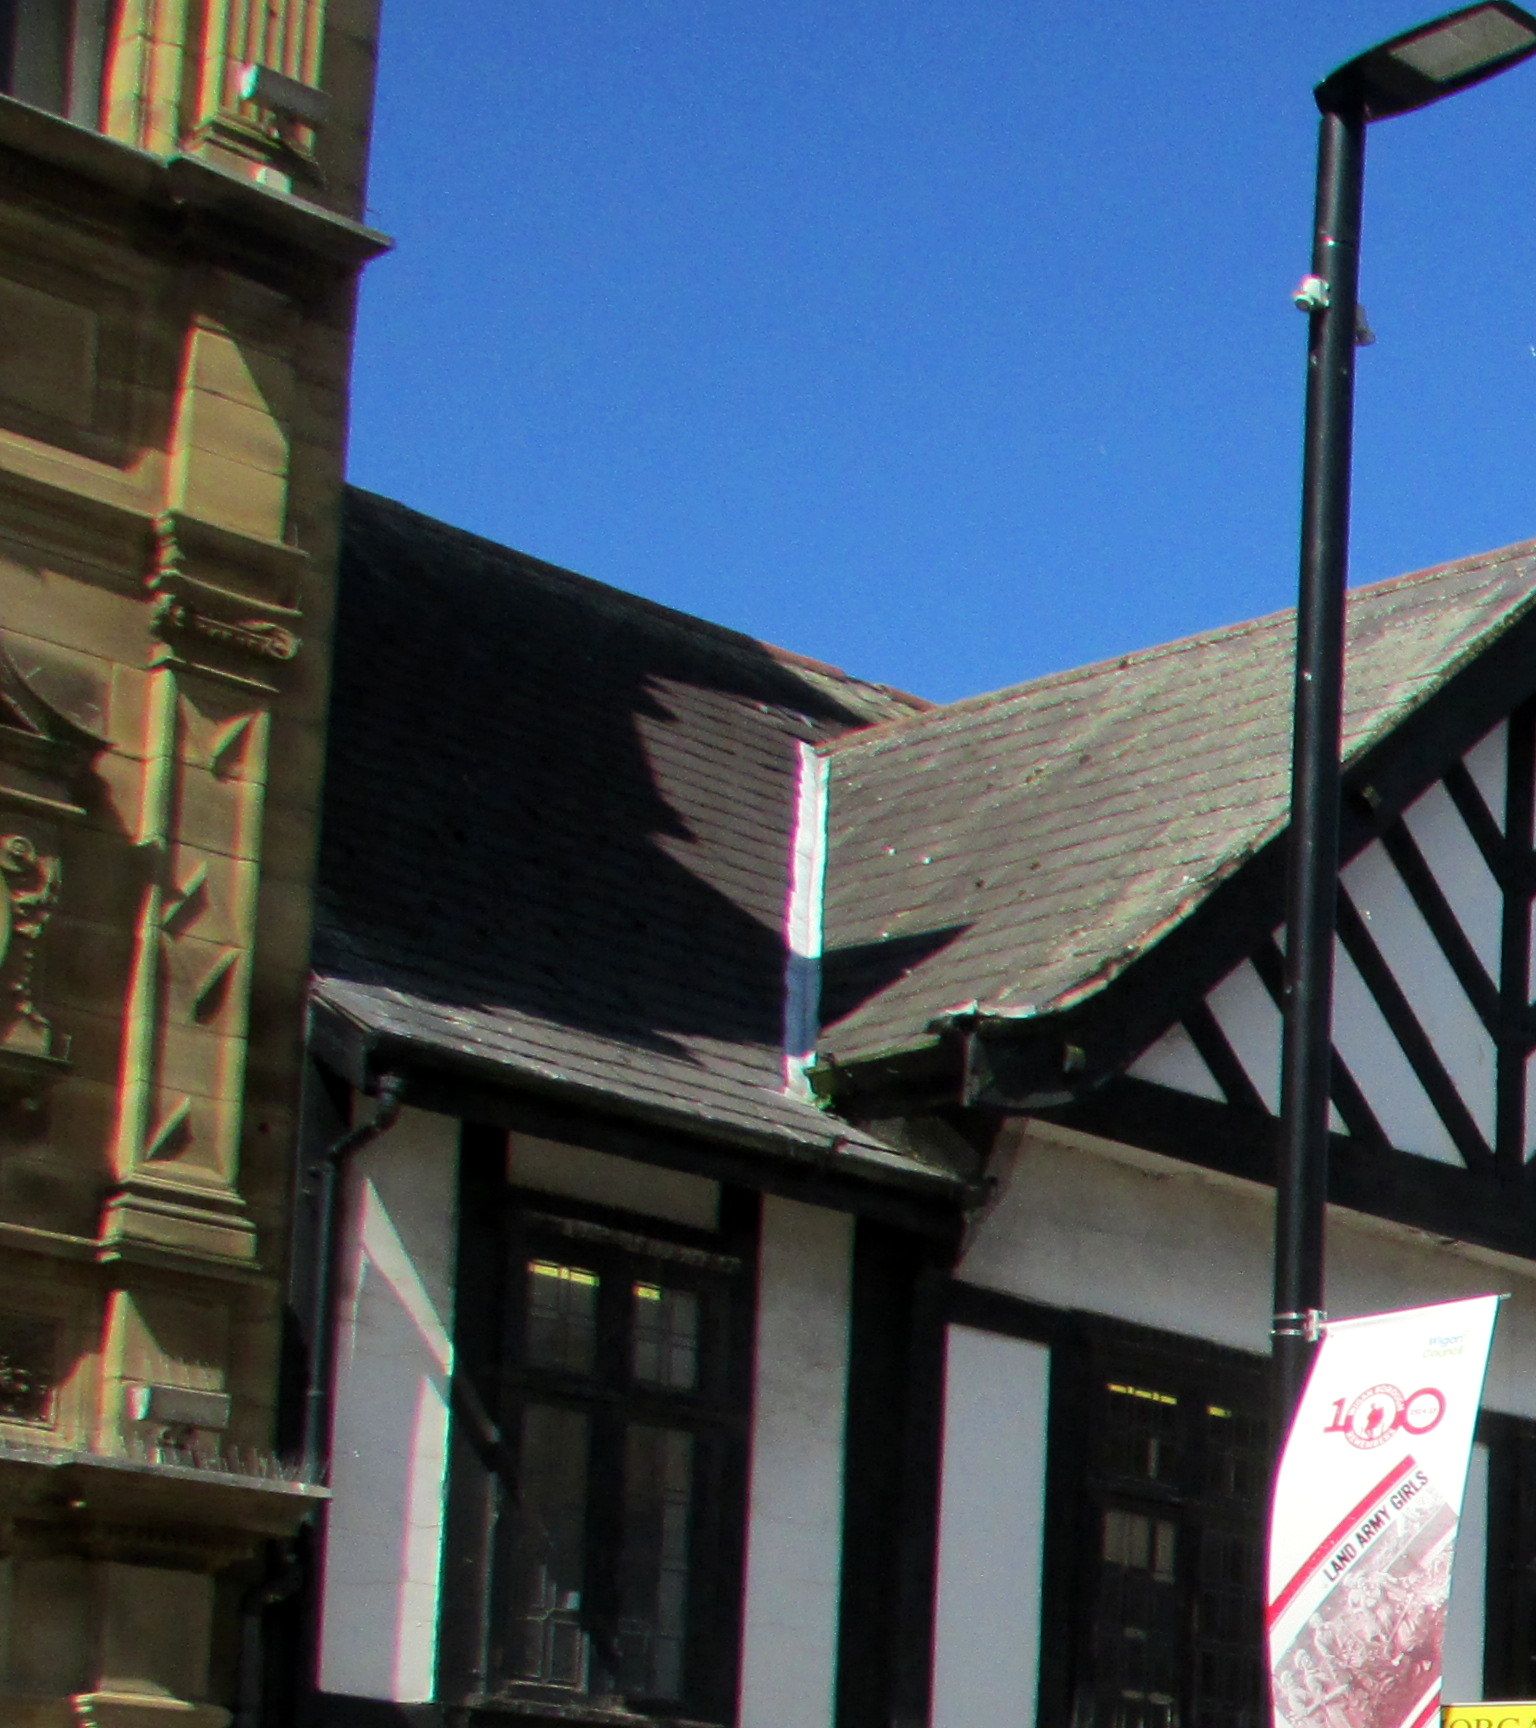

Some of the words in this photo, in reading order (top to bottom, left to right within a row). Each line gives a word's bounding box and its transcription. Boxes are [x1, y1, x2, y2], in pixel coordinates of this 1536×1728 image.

[1324, 1543, 1357, 1582] LAND
[1355, 1505, 1390, 1548] ARMY
[1389, 1471, 1428, 1510] GIRLS
